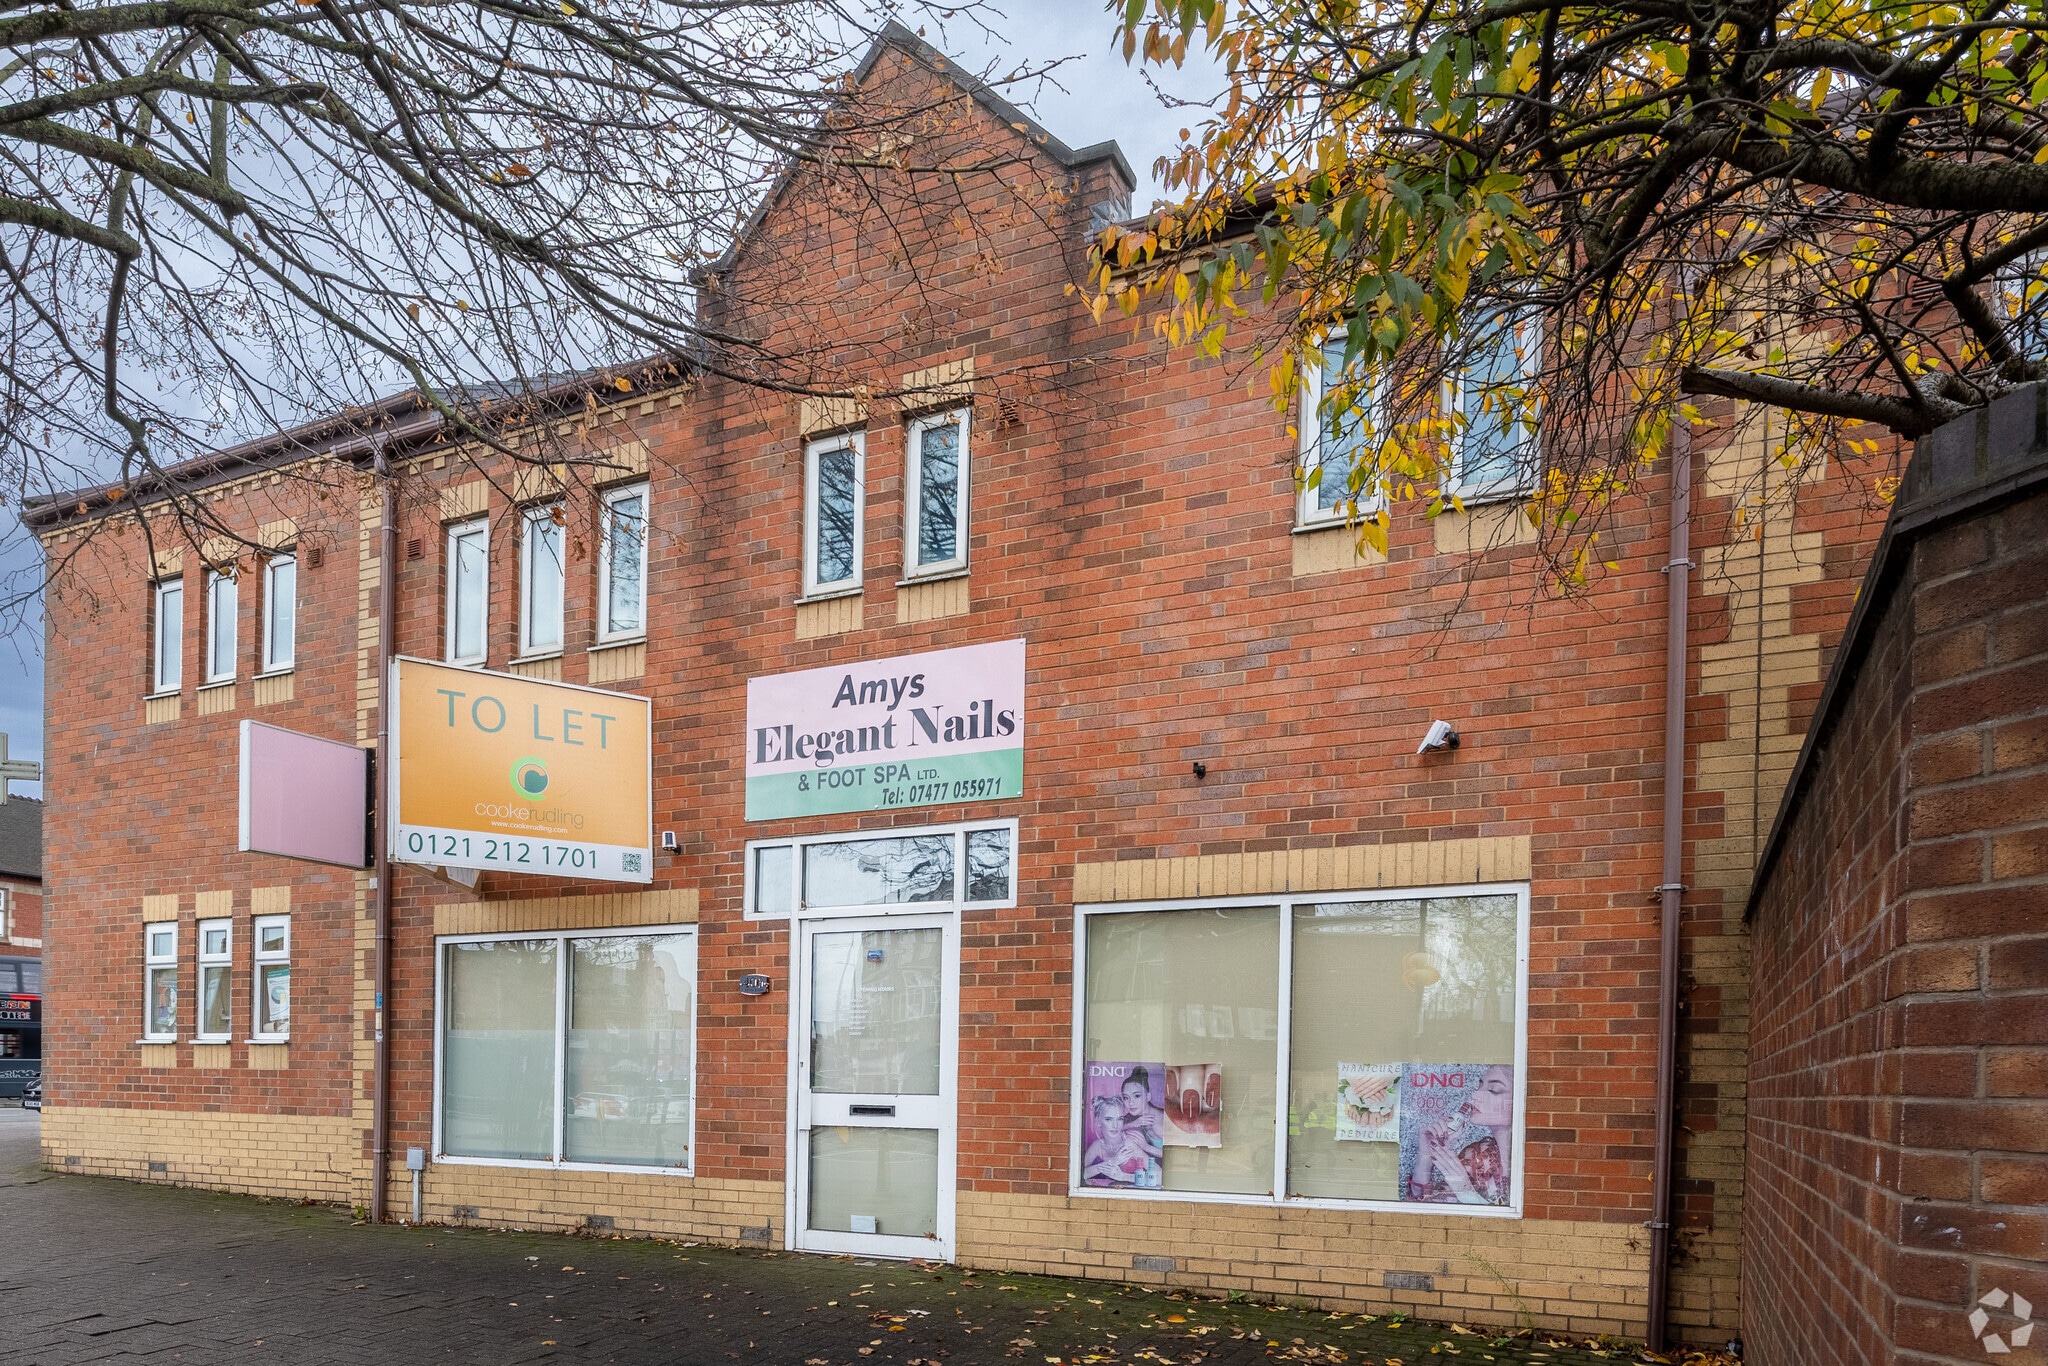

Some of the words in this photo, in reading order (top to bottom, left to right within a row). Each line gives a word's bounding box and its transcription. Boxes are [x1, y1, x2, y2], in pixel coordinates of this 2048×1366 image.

[831, 672, 926, 712] Amys
[436, 688, 507, 734] TO
[532, 703, 617, 750] LET
[752, 714, 898, 768] Elegant
[907, 698, 1016, 748] Nails
[798, 773, 810, 792] &
[817, 767, 866, 790] FOOT
[873, 763, 911, 785] SPA
[917, 768, 940, 780] LTD.
[882, 787, 904, 805] Tel:
[908, 782, 949, 804] 07477
[952, 776, 1002, 800] 055971
[474, 802, 584, 830] cookerudling
[490, 820, 568, 834] www.cookerudling.com
[408, 831, 471, 858] 0121
[484, 839, 531, 863] 212
[542, 845, 597, 869] 1701
[1341, 1064, 1401, 1074] MANICURE
[1340, 1129, 1397, 1141] PEDICURE
